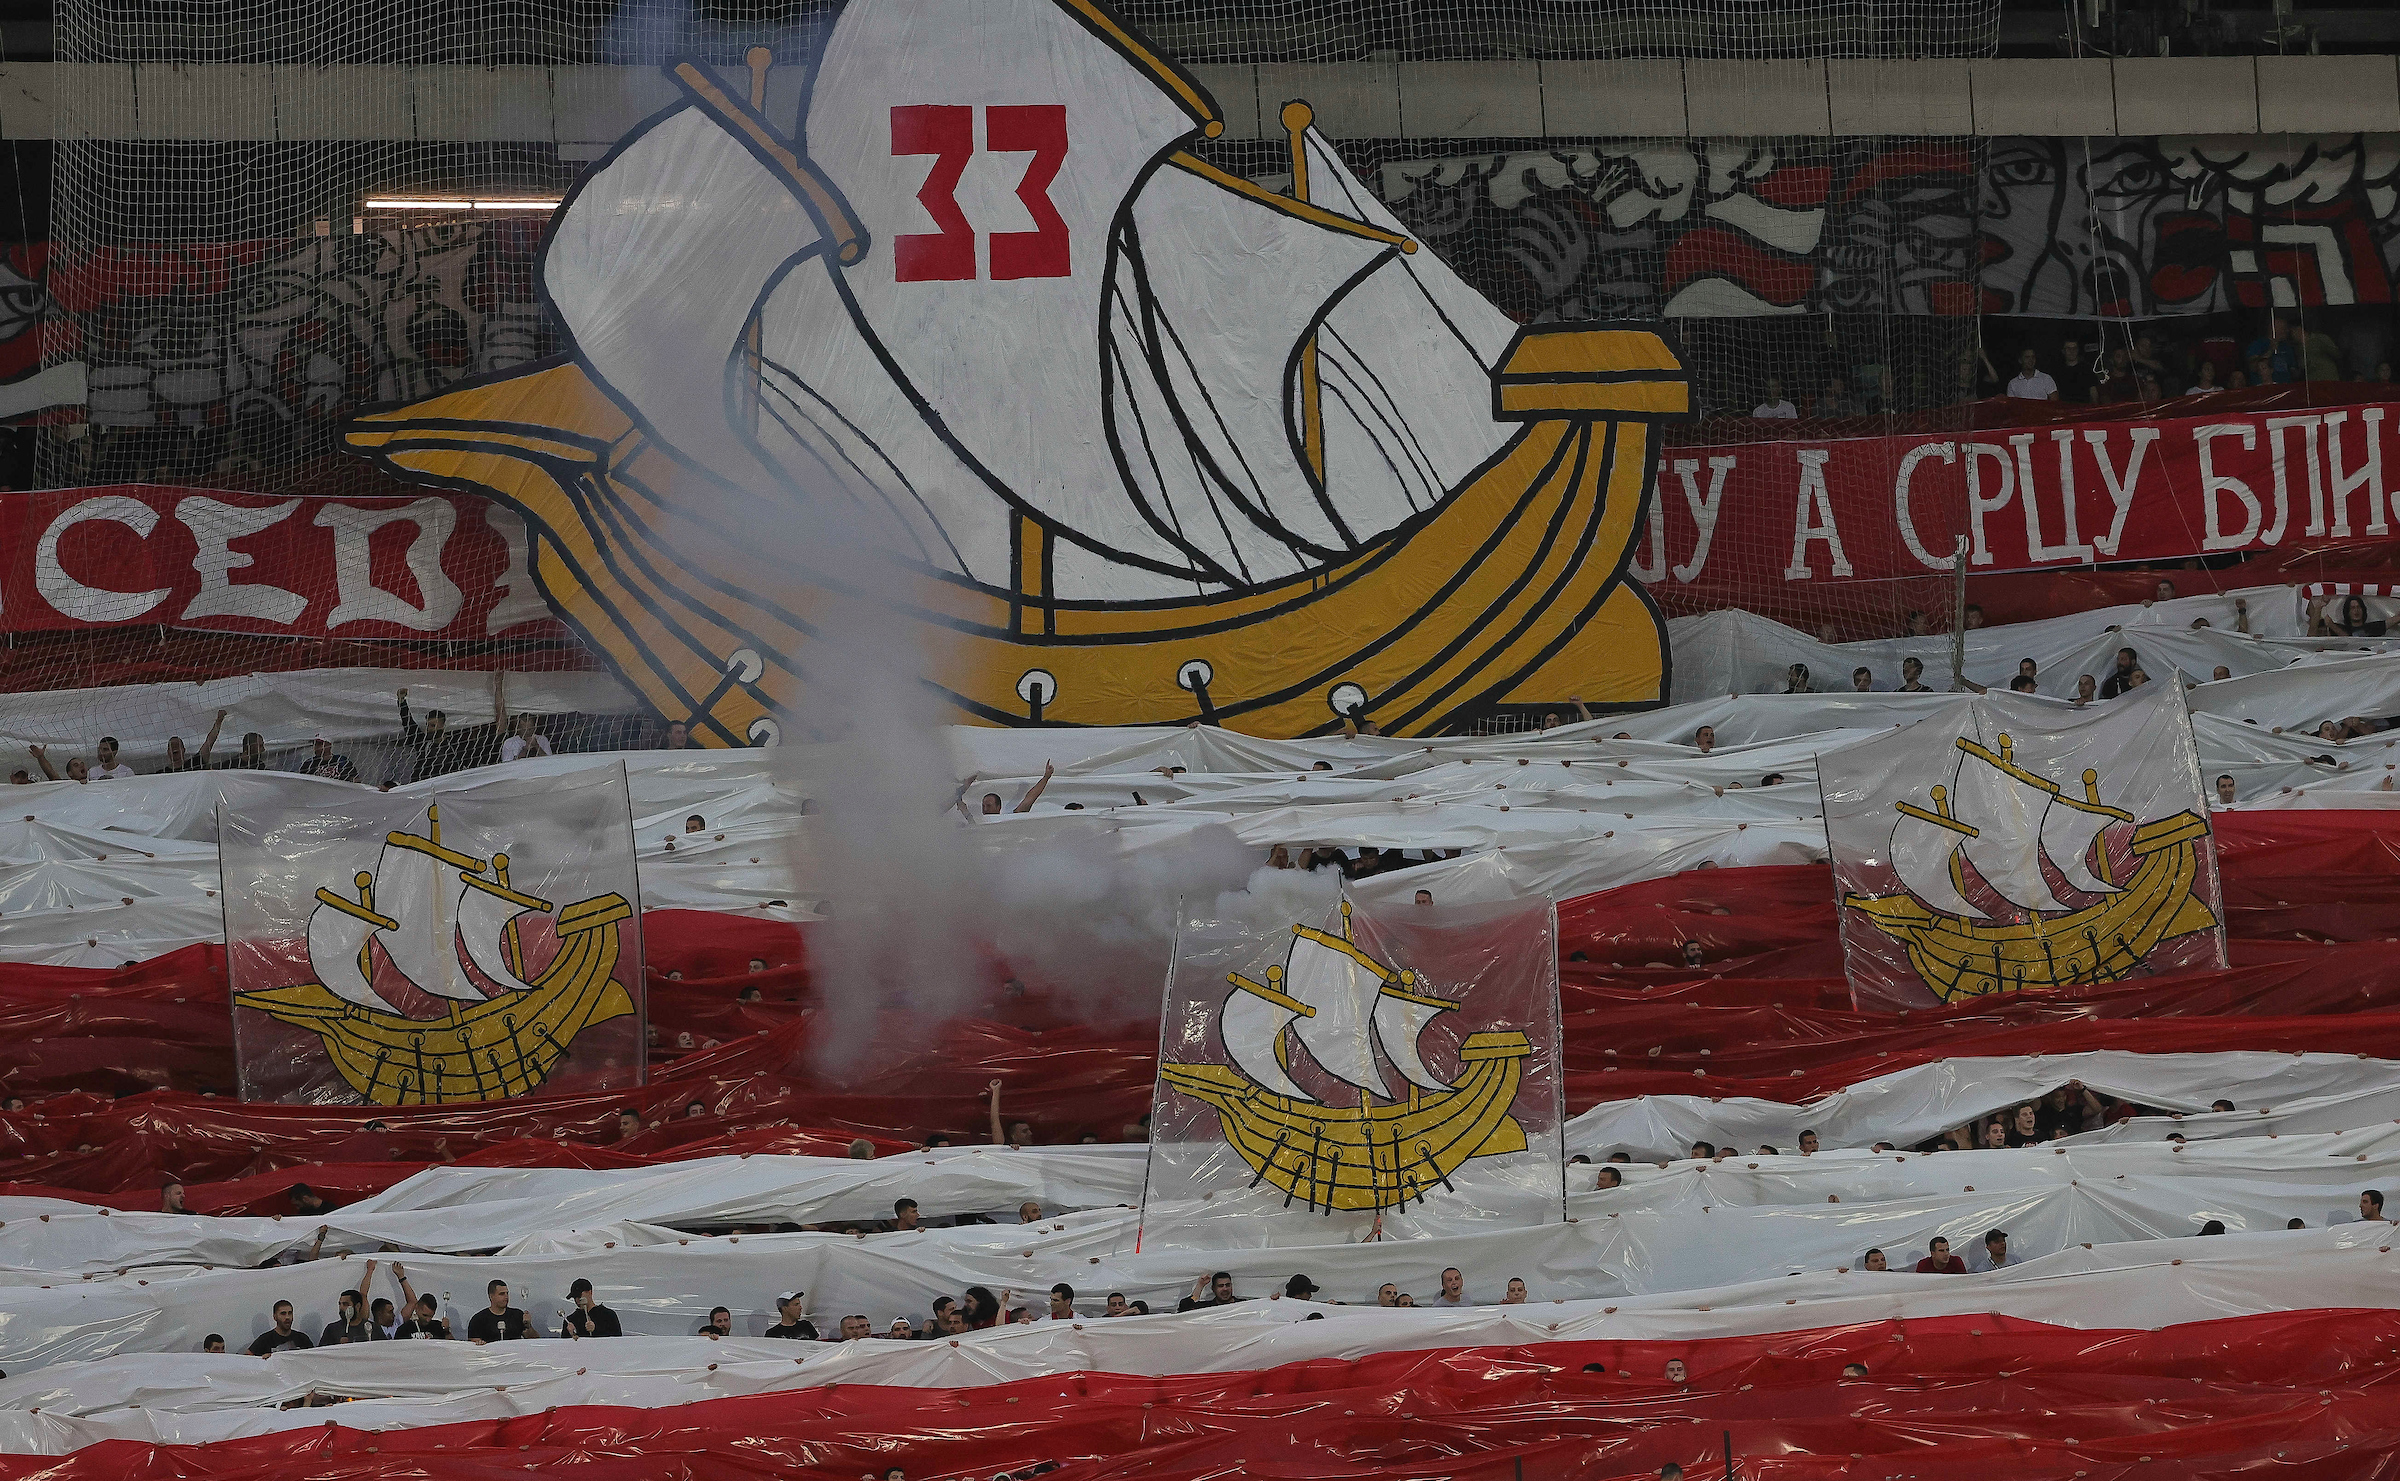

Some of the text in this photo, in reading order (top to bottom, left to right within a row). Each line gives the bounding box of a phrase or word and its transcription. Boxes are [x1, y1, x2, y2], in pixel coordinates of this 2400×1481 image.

[890, 104, 1071, 282] 33
[1785, 449, 1854, 581] А
[1895, 427, 2160, 570] СРЦУ
[2193, 407, 2400, 551] БЛИ
